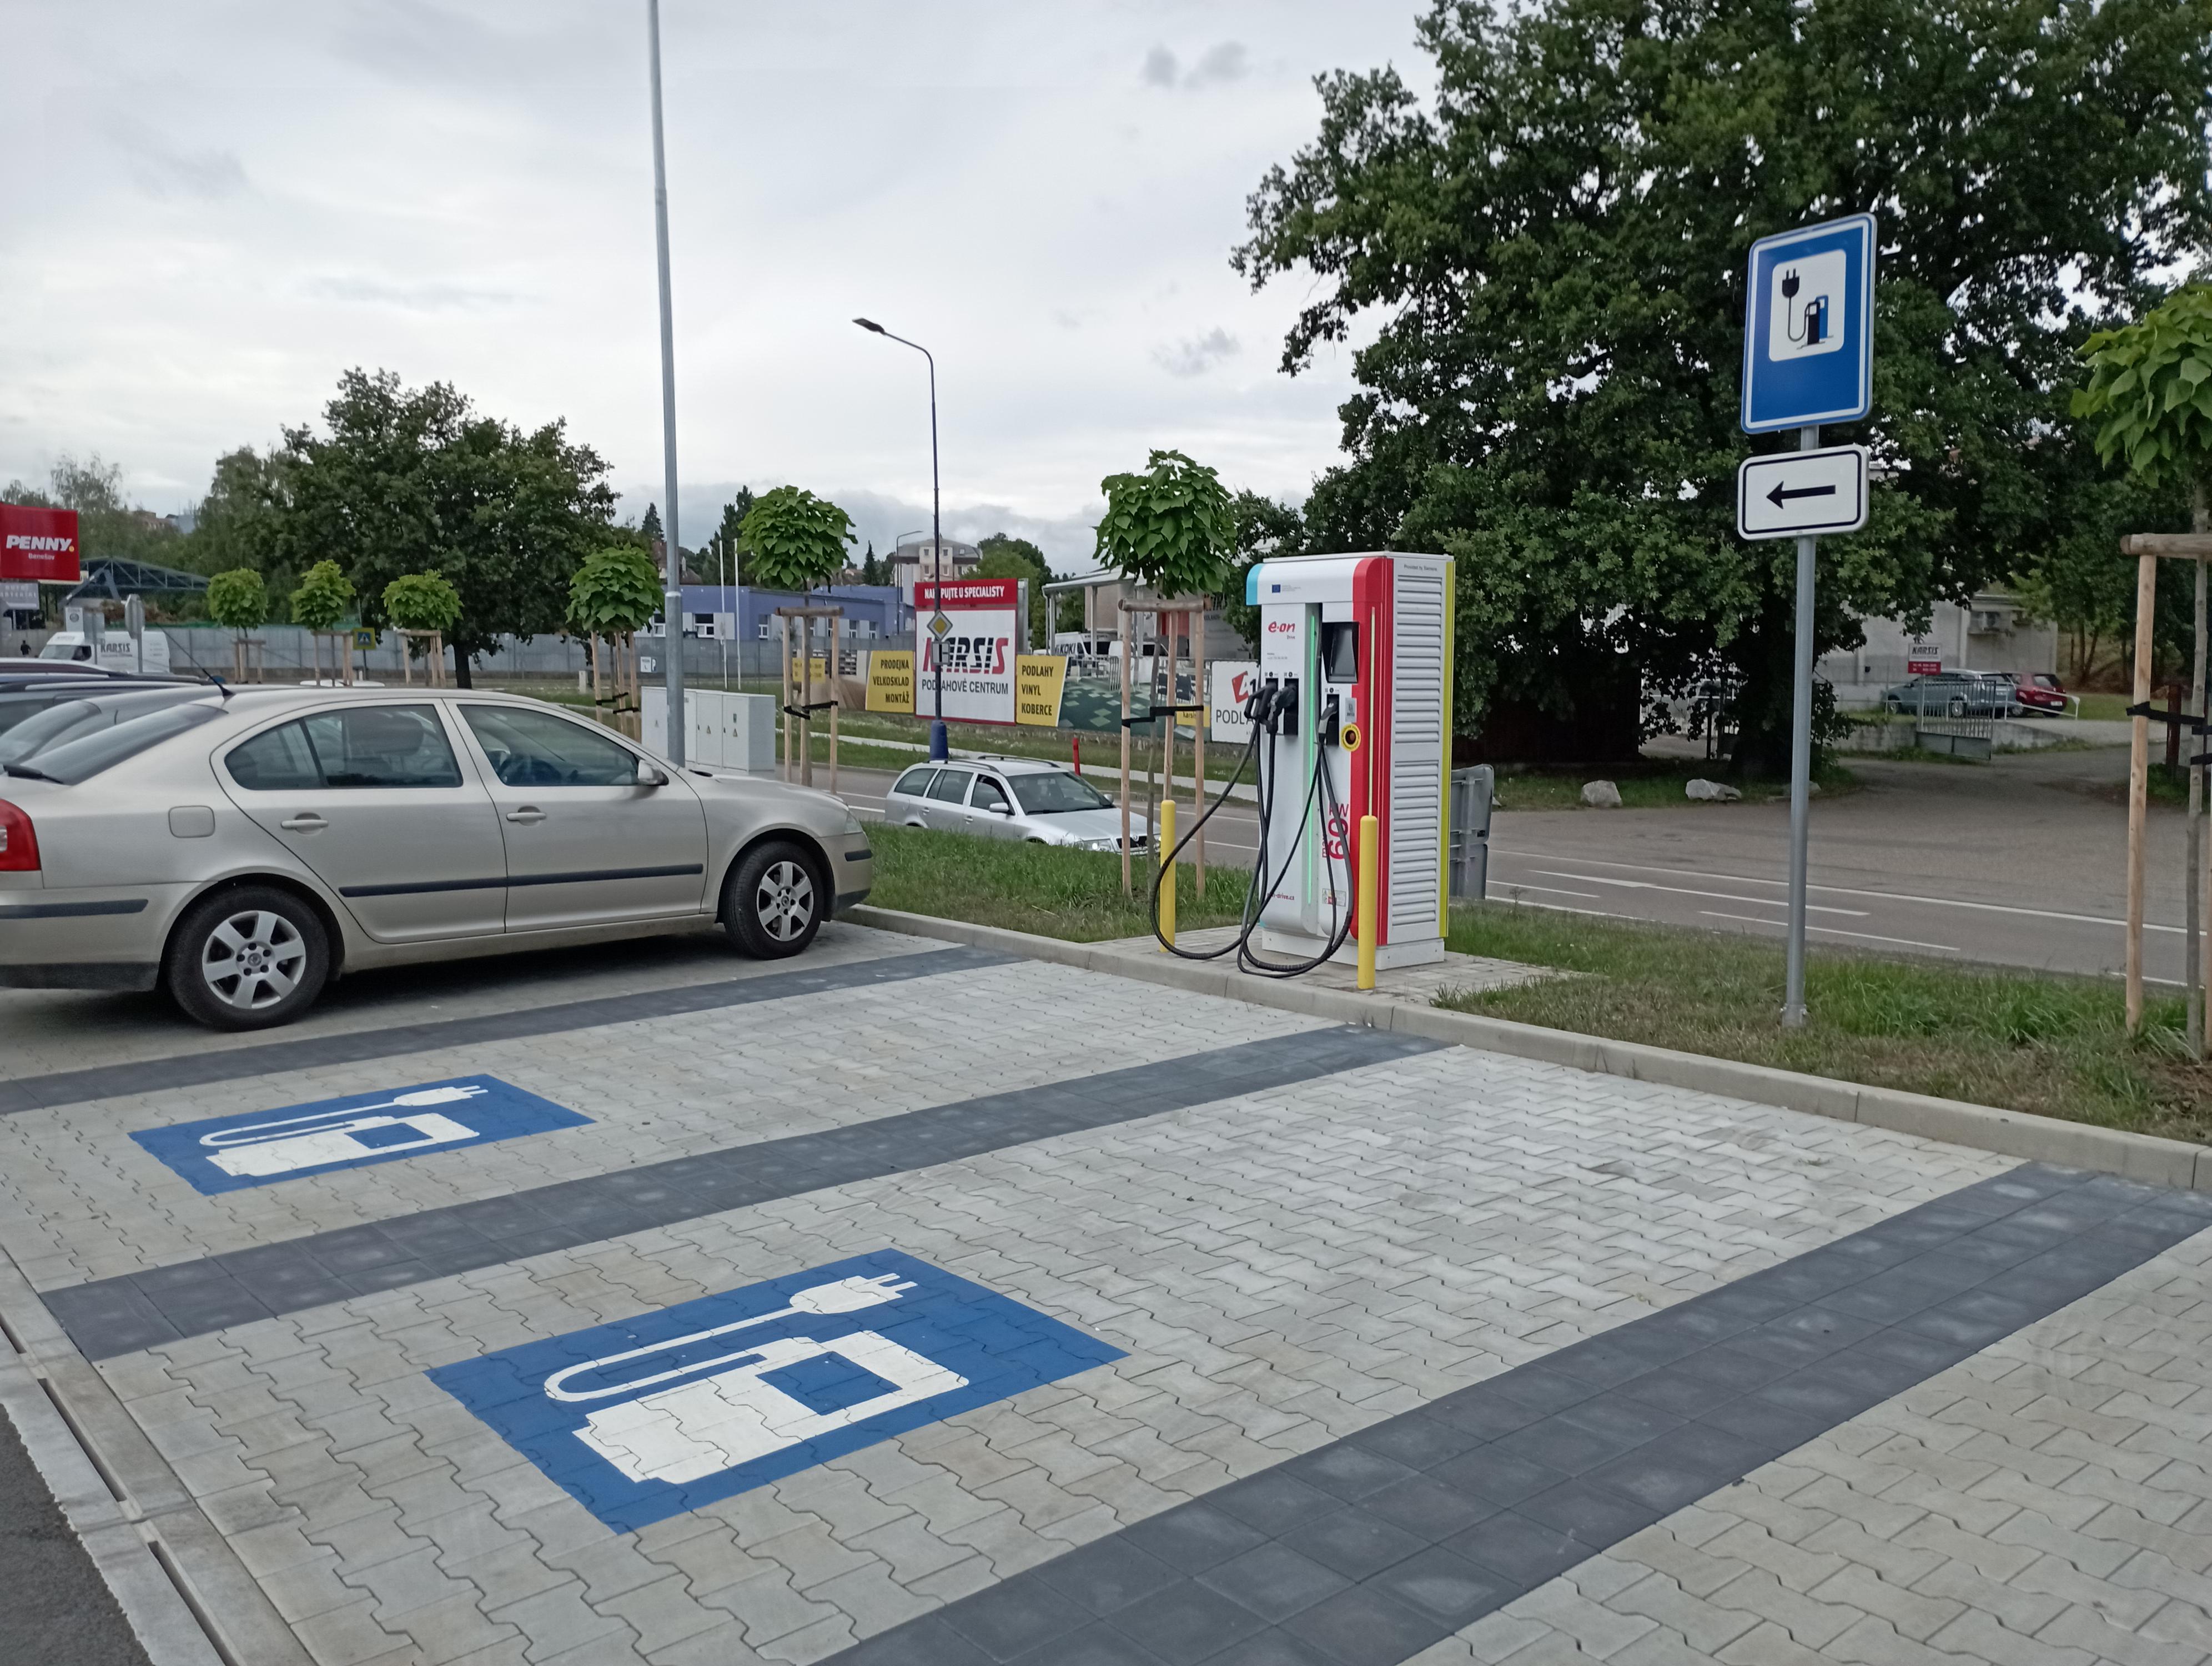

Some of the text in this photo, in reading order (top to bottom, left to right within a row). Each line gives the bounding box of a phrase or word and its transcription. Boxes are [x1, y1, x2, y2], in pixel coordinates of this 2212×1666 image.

[924, 586, 1004, 601] NAPUJTE U SPECIALISTY
[1912, 646, 1939, 655] KARSIS
[881, 659, 909, 671] PRODEJNA
[1022, 665, 1054, 677] PODLAHY
[873, 675, 909, 686] VELKOSKLAD
[922, 677, 1009, 694] PODAHOVÉ CENTRUM
[1022, 684, 1042, 696] VINYL
[885, 690, 909, 704] MONTÁŽ
[1022, 702, 1053, 716] KOBERCE
